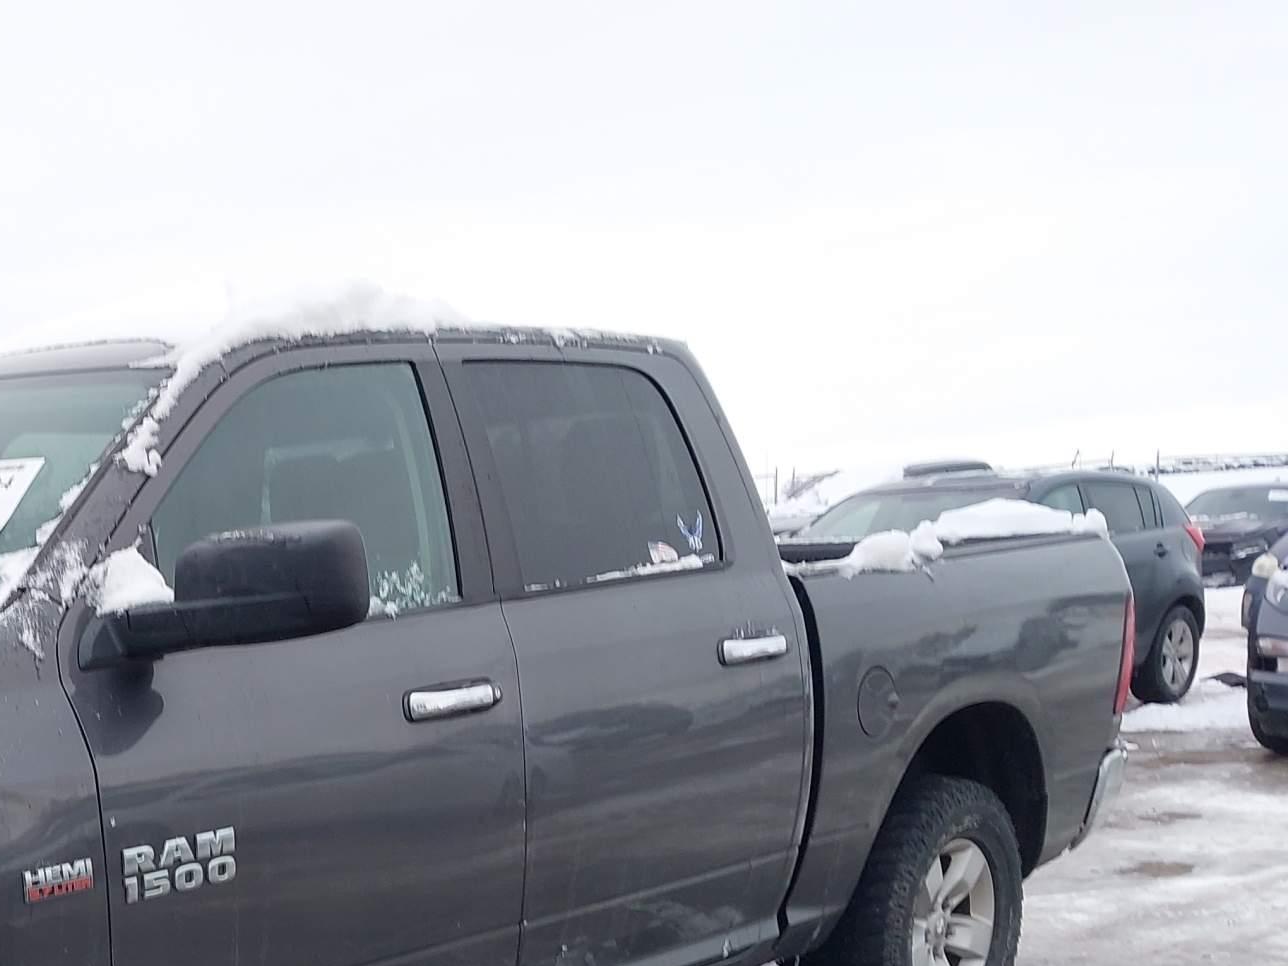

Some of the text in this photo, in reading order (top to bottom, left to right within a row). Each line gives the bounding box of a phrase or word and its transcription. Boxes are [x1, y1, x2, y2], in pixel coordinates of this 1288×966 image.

[23, 858, 93, 888] HEMI
[122, 826, 235, 876] RAM
[124, 855, 237, 904] 1500
